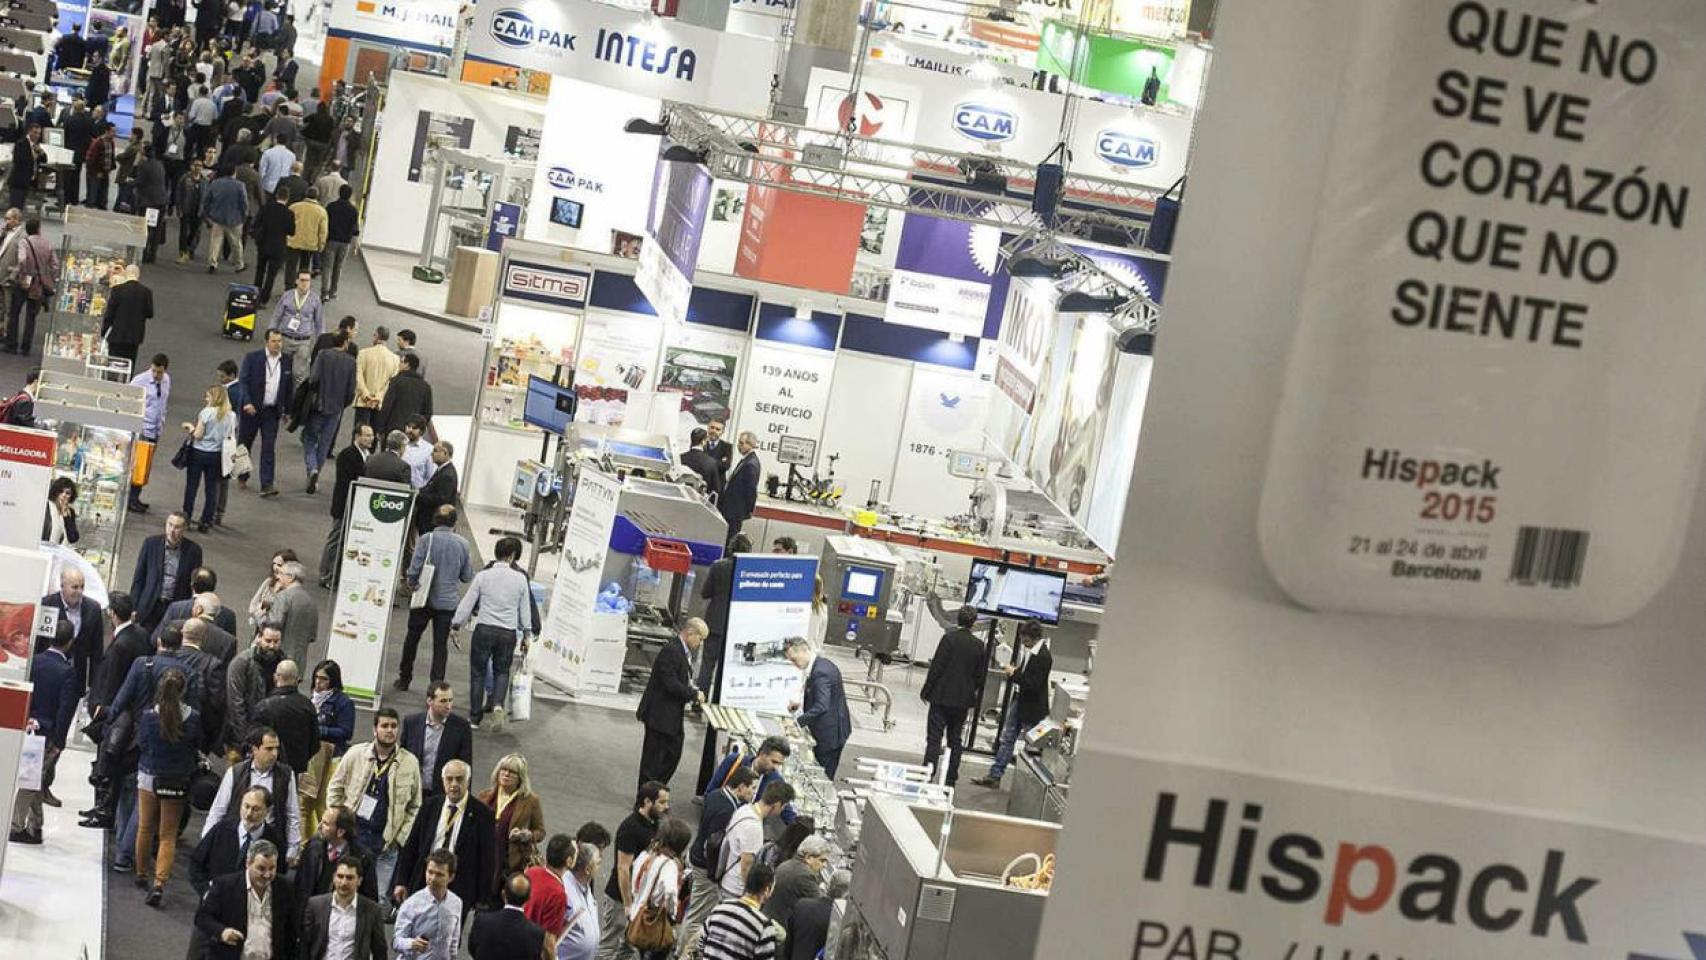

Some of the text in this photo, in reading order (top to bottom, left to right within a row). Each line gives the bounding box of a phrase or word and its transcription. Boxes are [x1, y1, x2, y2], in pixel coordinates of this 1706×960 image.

[595, 28, 697, 82] INTESA
[1448, 1, 1658, 86] QUE NO
[1432, 69, 1591, 142] SE VE
[957, 111, 1013, 134] CAM
[1099, 138, 1155, 161] CAM
[1421, 140, 1690, 230] CORAZÓN
[1406, 210, 1619, 284] QUE NO
[512, 273, 580, 294] sitma
[1391, 279, 1589, 348] SIENTE
[762, 365, 782, 377] 139
[777, 386, 794, 398] AL
[755, 402, 812, 420] SERVICIO
[910, 443, 936, 456] 1876
[1361, 448, 1501, 490] Hispack
[1420, 492, 1497, 524] 2015
[1348, 535, 1487, 561] 21 al 24 de abril
[1391, 559, 1482, 581] Barcelona
[44, 616, 53, 625] D
[1142, 792, 1601, 944] Hispack
